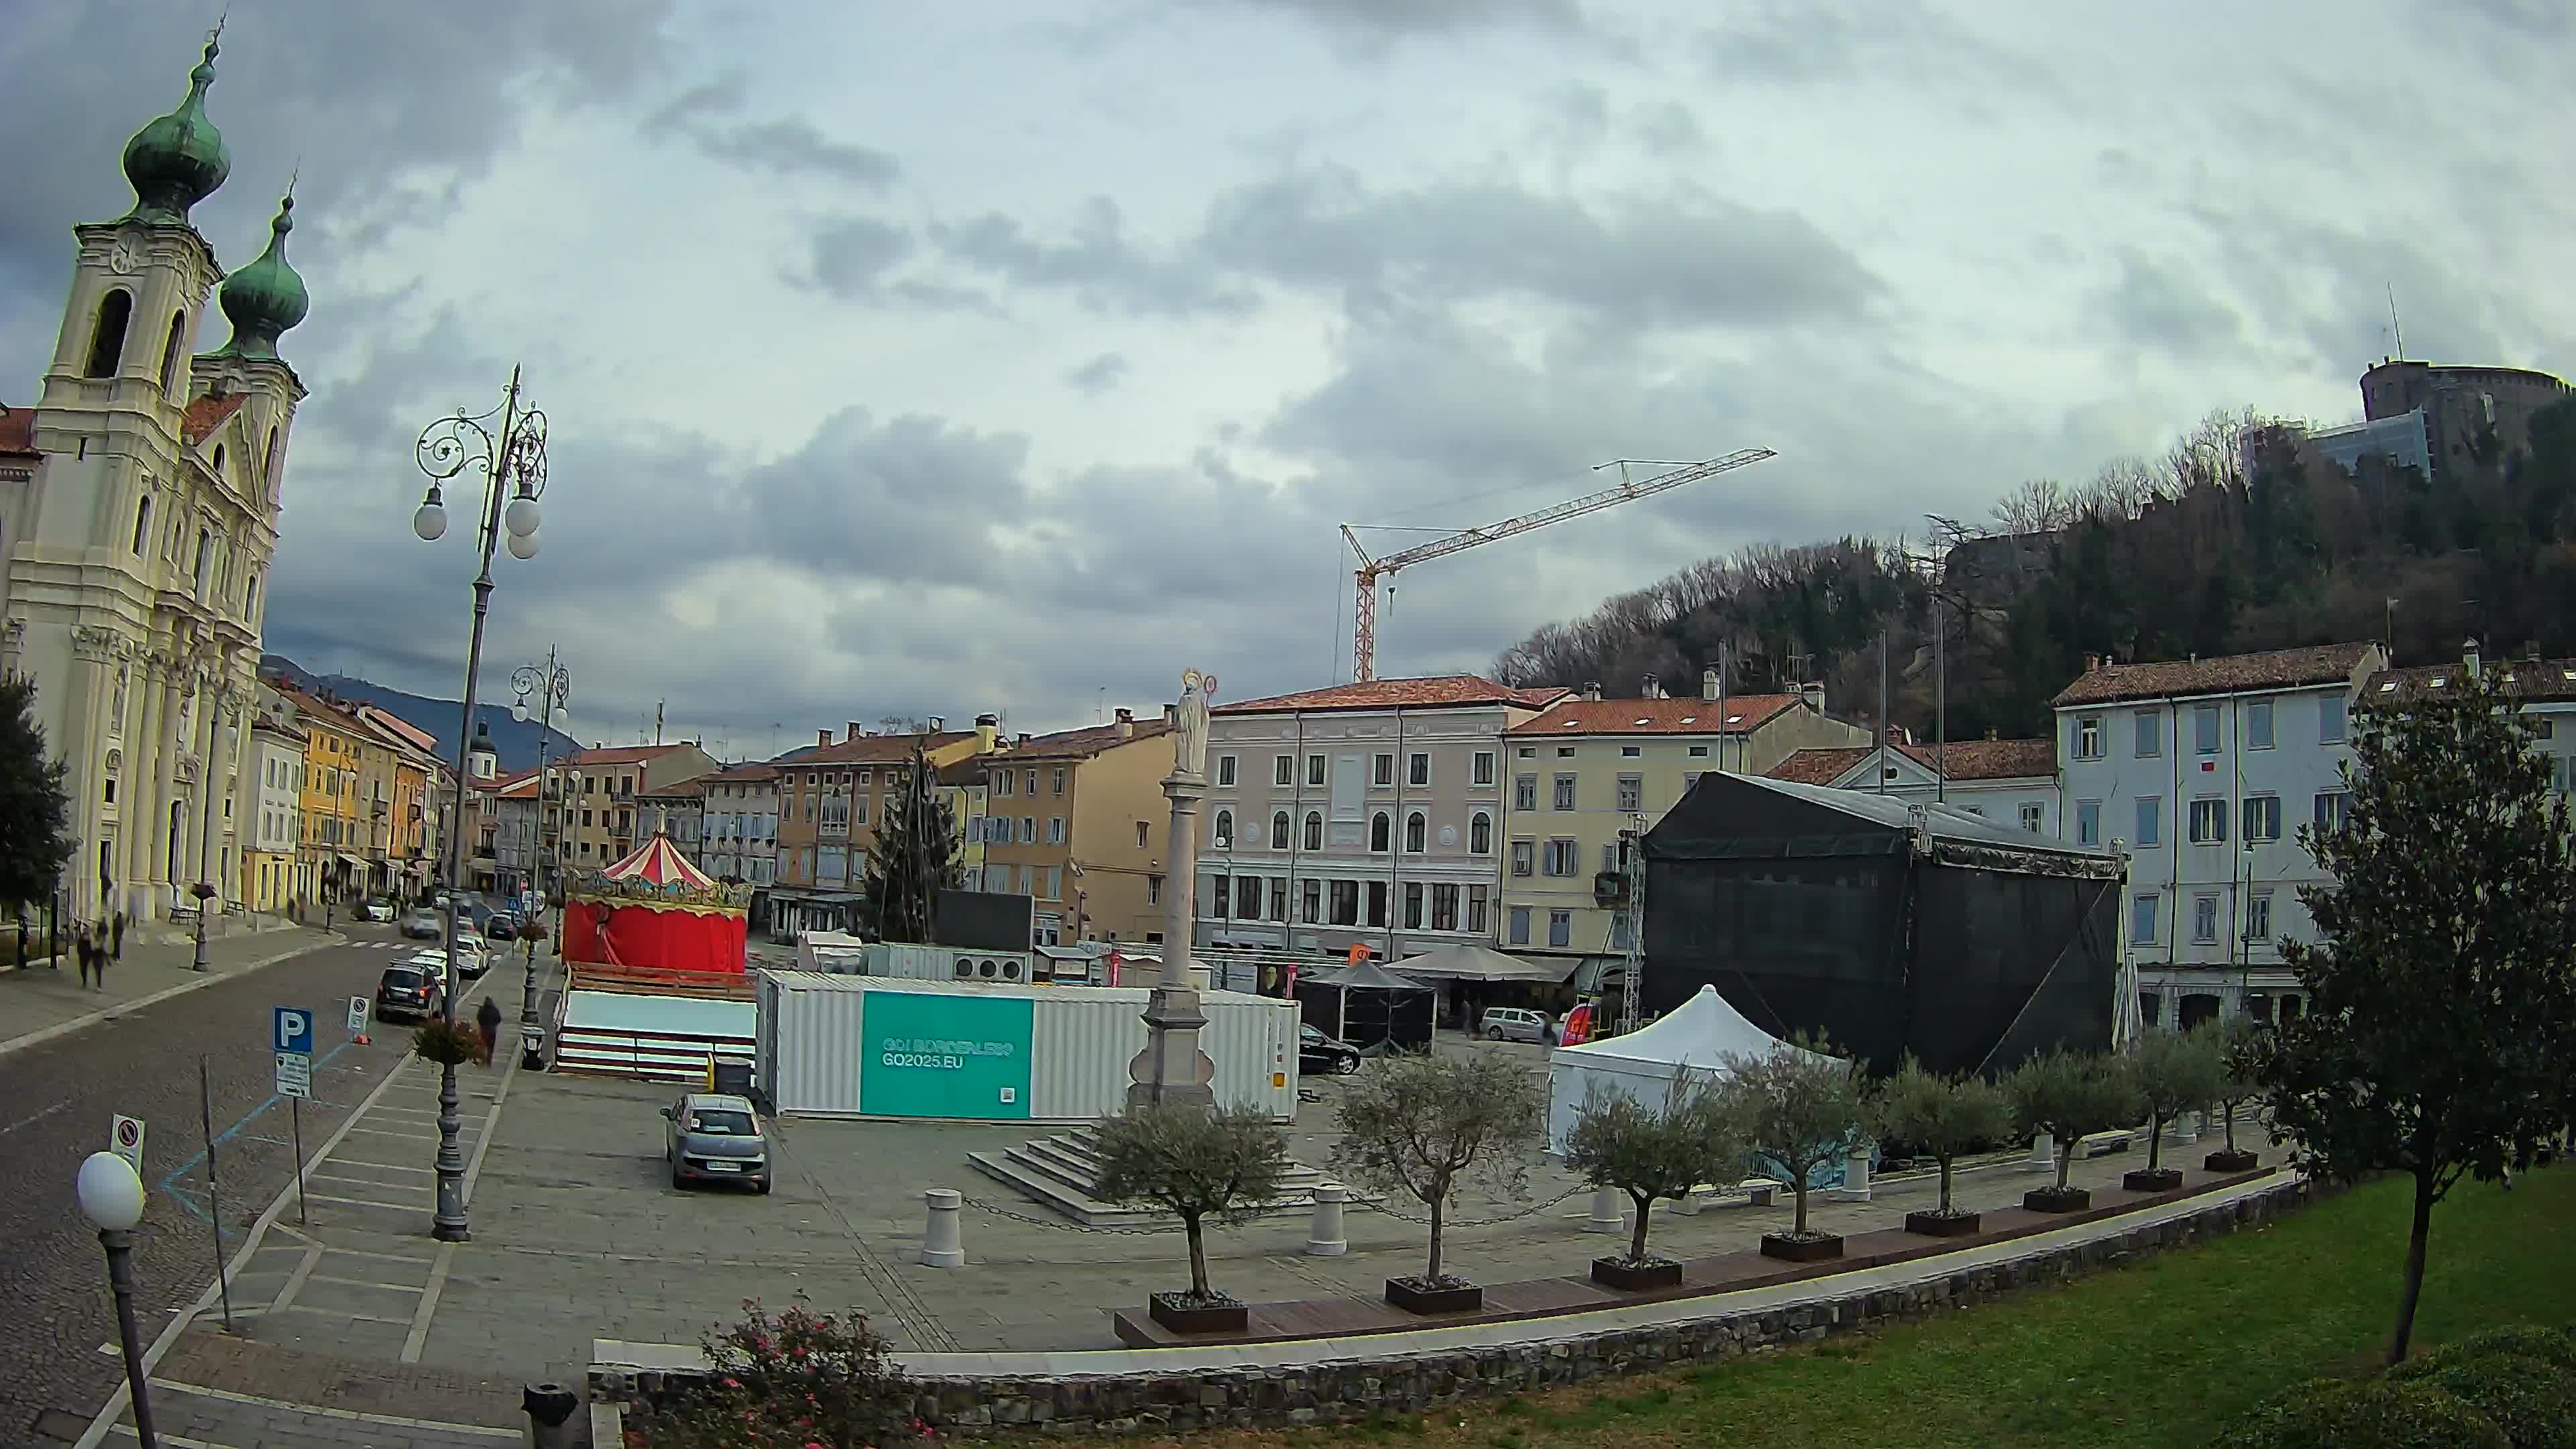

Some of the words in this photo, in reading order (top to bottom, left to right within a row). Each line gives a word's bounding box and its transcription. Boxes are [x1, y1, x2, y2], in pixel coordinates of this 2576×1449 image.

[280, 1012, 305, 1047] P
[883, 1038, 910, 1052] GO!
[913, 1039, 1014, 1057] BORDERLESS
[882, 1053, 964, 1069] GO2025.EU
